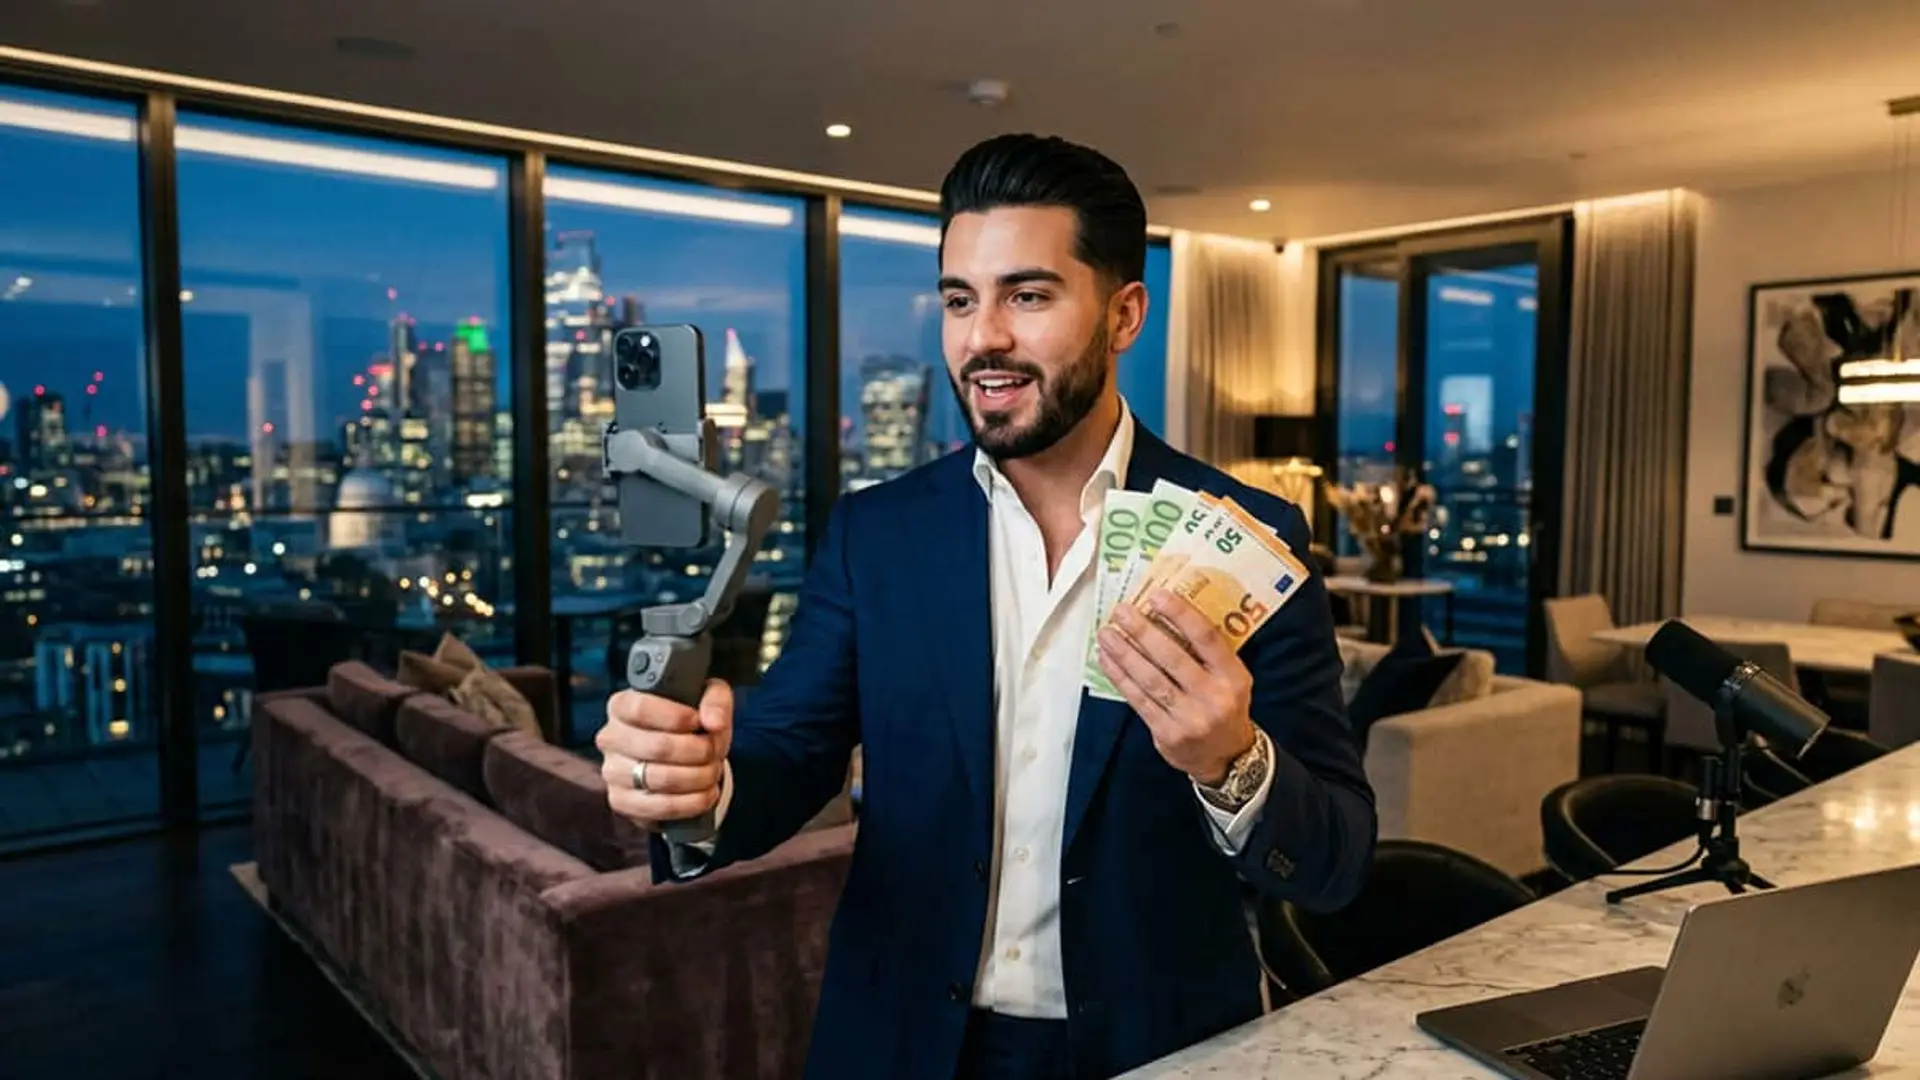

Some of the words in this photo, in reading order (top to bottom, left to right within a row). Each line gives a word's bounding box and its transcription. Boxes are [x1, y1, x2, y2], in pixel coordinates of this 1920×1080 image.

[1104, 508, 1140, 564] 100
[1140, 500, 1183, 552] 100
[1216, 527, 1243, 555] 50
[1223, 592, 1269, 638] 50
